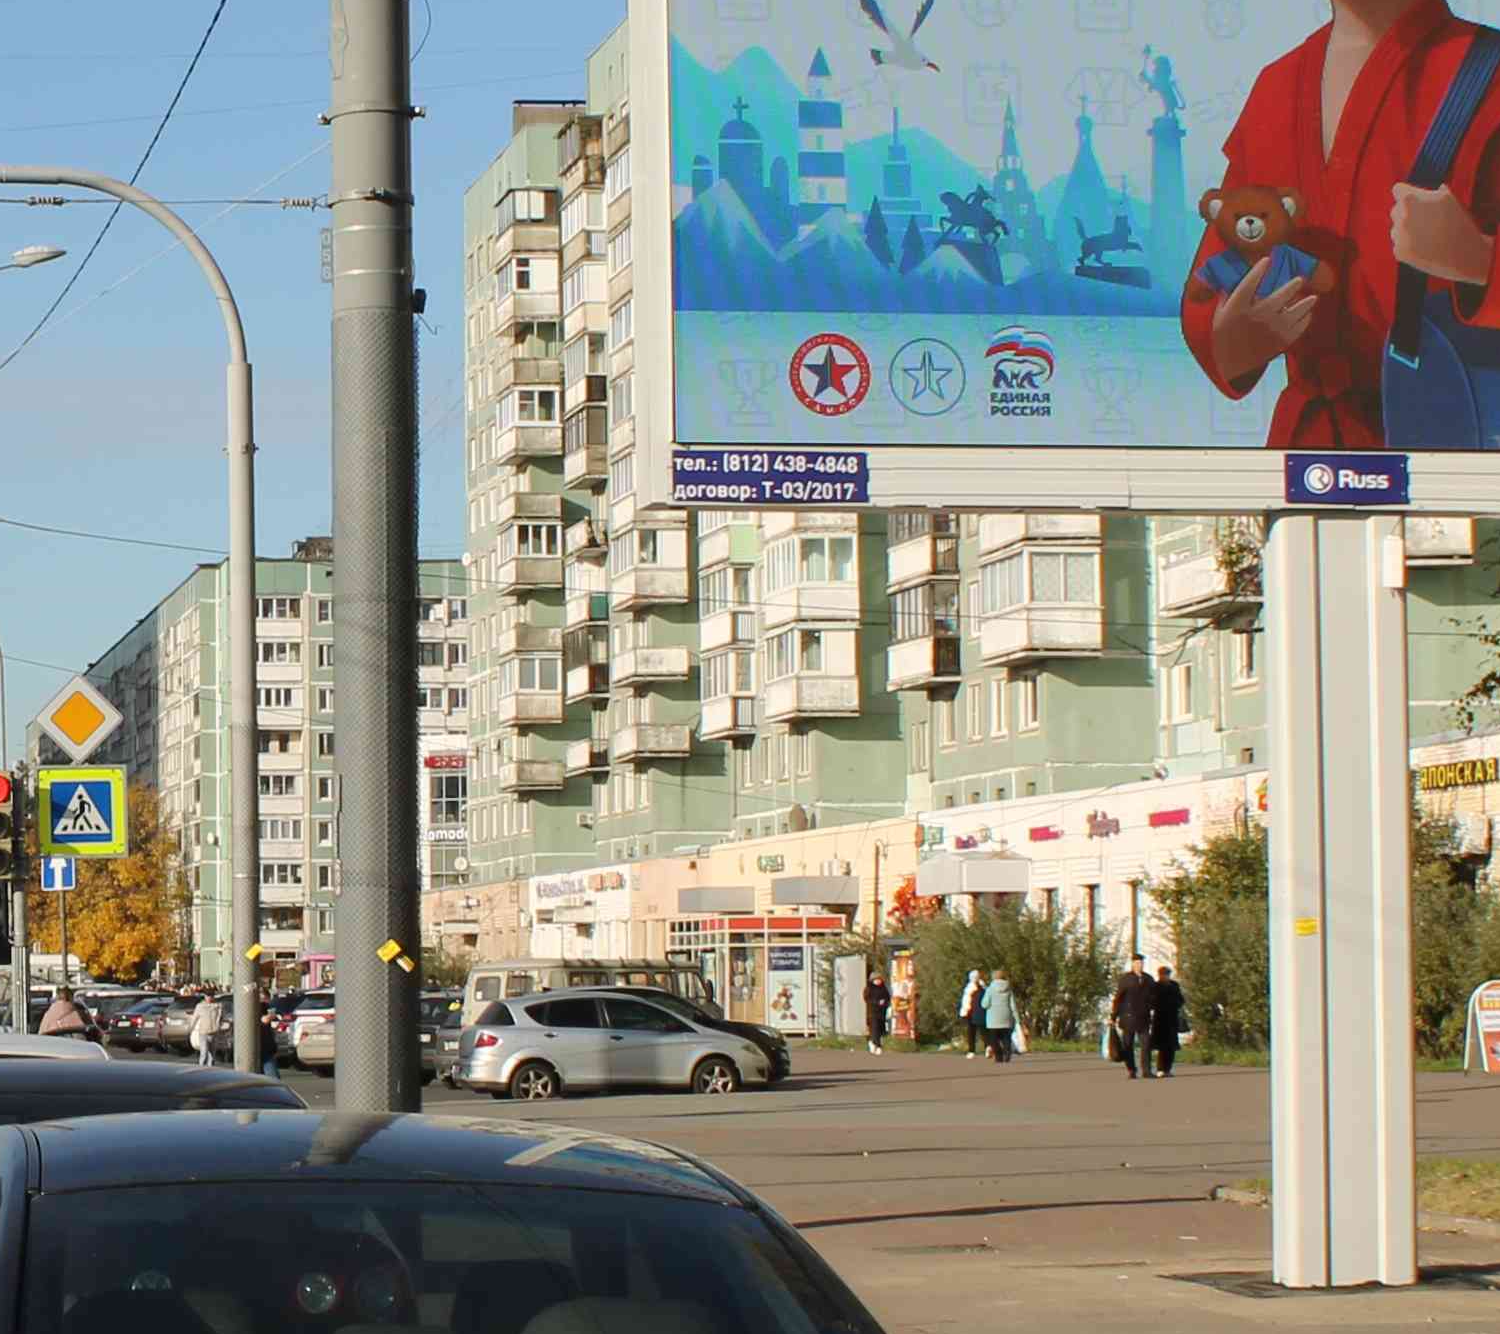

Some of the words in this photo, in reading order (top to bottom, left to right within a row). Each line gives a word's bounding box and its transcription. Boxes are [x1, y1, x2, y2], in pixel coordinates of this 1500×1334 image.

[990, 392, 1051, 405] ЕДИНАЯ
[990, 405, 1051, 417] РОССИЯ
[674, 456, 718, 472] тел.:
[723, 452, 769, 473] (812)
[773, 454, 858, 474] 438-4848
[1338, 468, 1390, 489] Russ
[674, 482, 757, 501] договор:
[761, 480, 855, 500] Т-03/2017
[1420, 756, 1498, 789] ЯПОНСКАЯ
